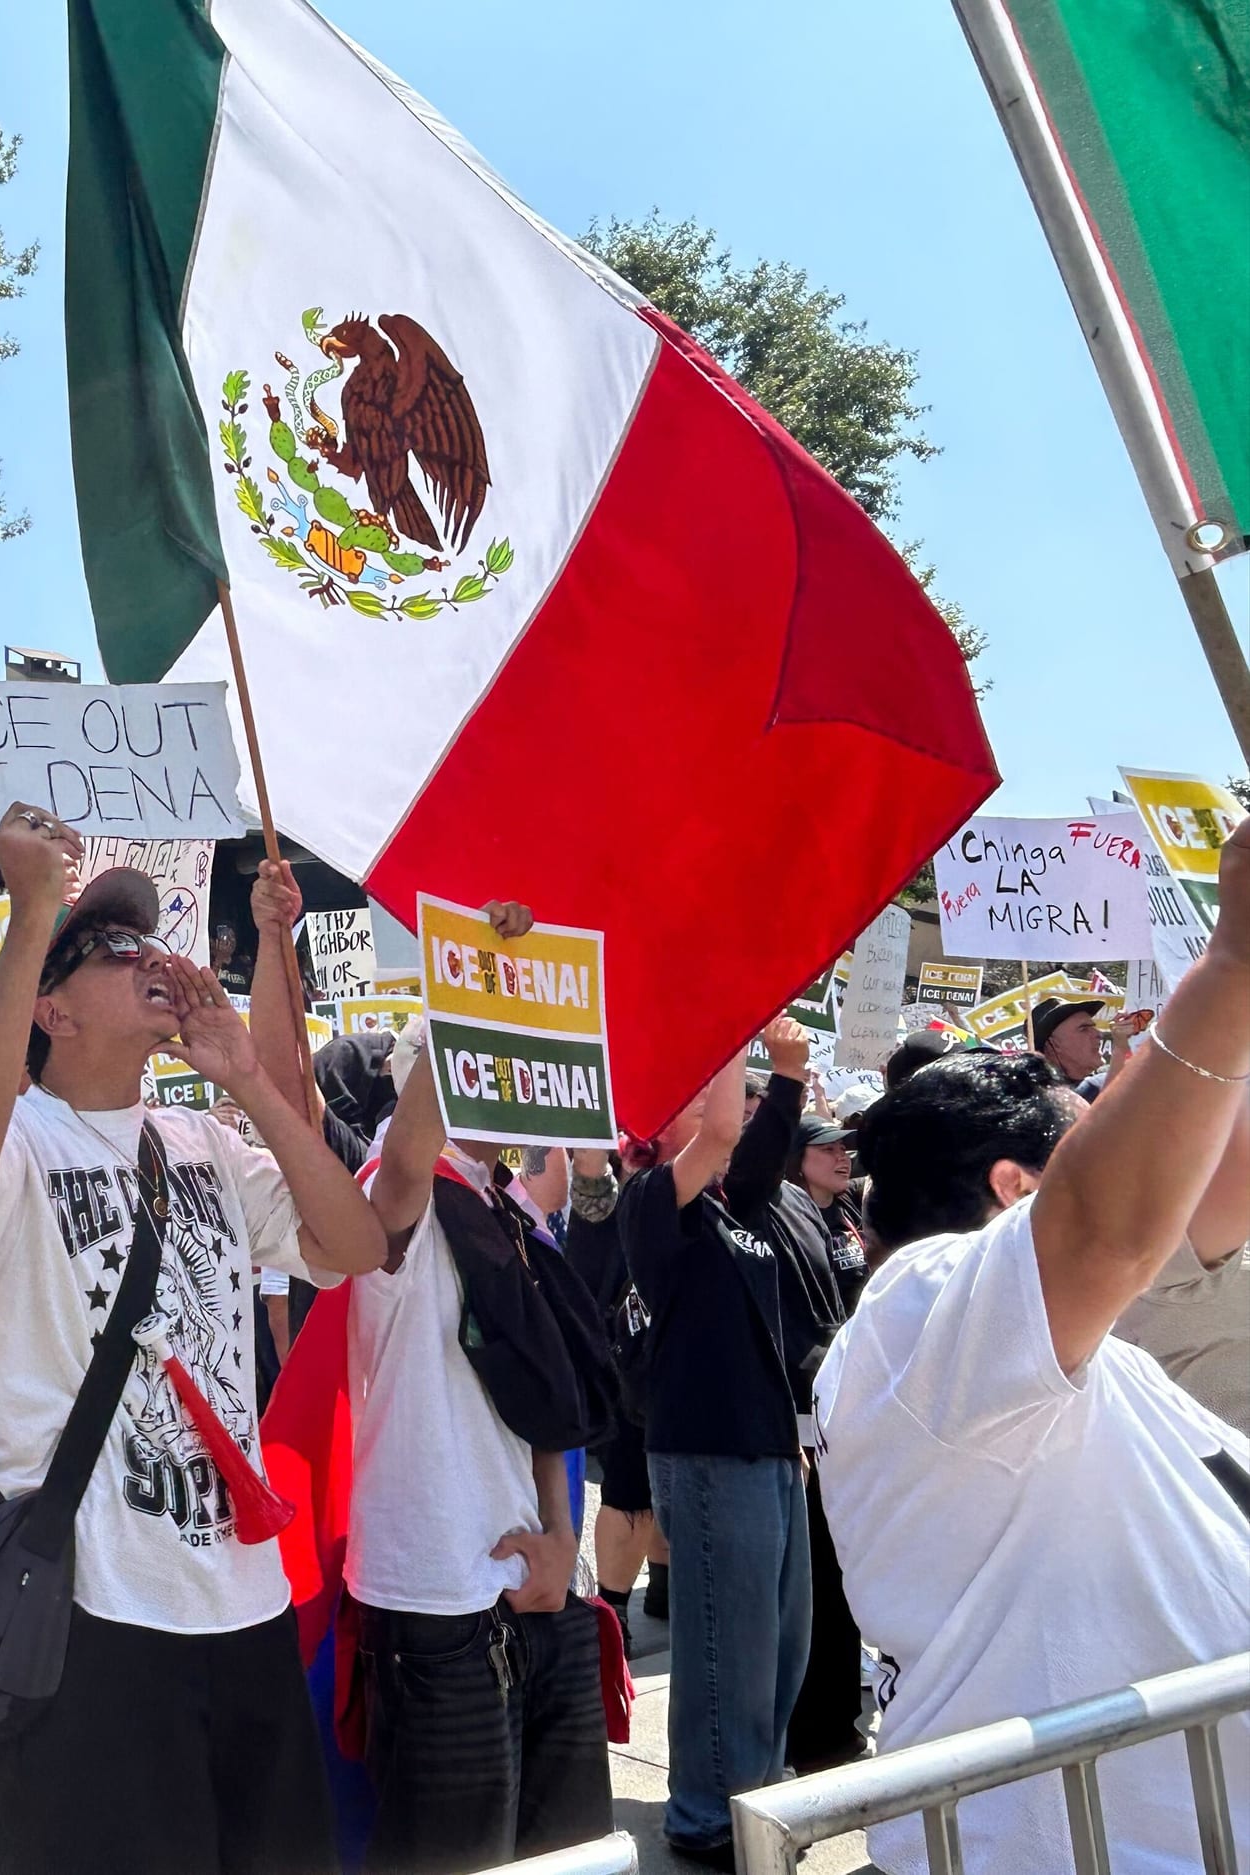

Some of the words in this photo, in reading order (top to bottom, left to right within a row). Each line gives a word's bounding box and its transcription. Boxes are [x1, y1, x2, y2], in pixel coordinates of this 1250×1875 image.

[82, 699, 209, 758] OUT
[47, 760, 231, 824] DENA
[1066, 822, 1142, 869] FUERA
[996, 865, 1041, 896] LA
[324, 912, 356, 931] THY
[333, 961, 360, 984] OR
[431, 936, 483, 992] ICE
[495, 953, 589, 1009] DENA!
[163, 1084, 195, 1106] ICE
[444, 1048, 499, 1101] ICE
[511, 1057, 600, 1111] DENA!
